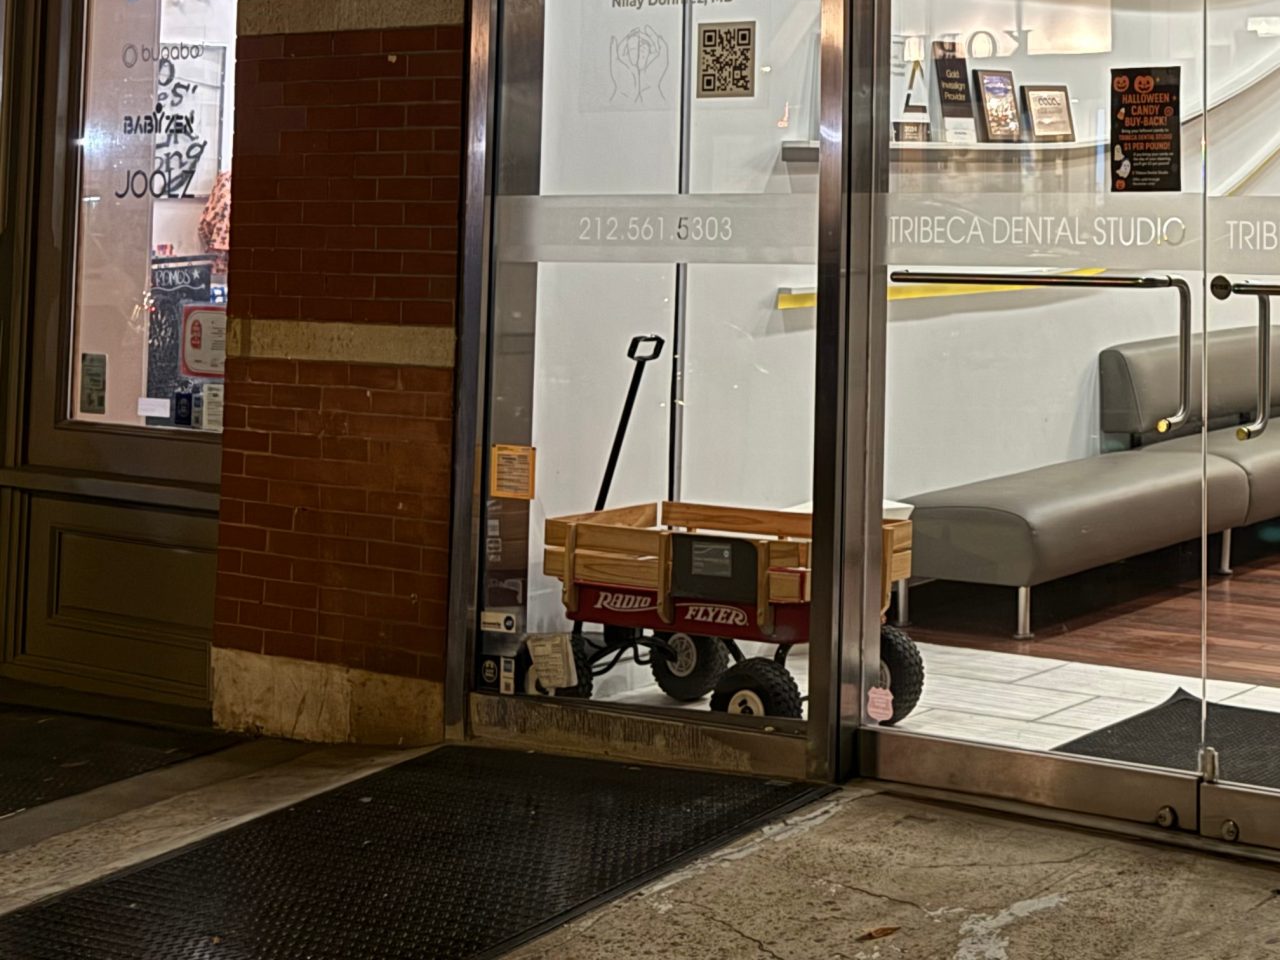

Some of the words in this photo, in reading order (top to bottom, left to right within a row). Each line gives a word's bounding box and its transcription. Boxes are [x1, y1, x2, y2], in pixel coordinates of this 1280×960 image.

[1121, 93, 1170, 104] HALLOWEEN
[1131, 105, 1160, 115] CANDY
[1124, 116, 1168, 127] BUY-BACK!
[115, 170, 195, 198] JOOLZ
[579, 216, 733, 240] 212.561.5303
[889, 216, 984, 245] TRIBECA
[993, 216, 1087, 246] DENTAL
[1093, 217, 1186, 246] STUDIO
[594, 591, 652, 612] RADIO
[685, 605, 747, 627] FLYER
